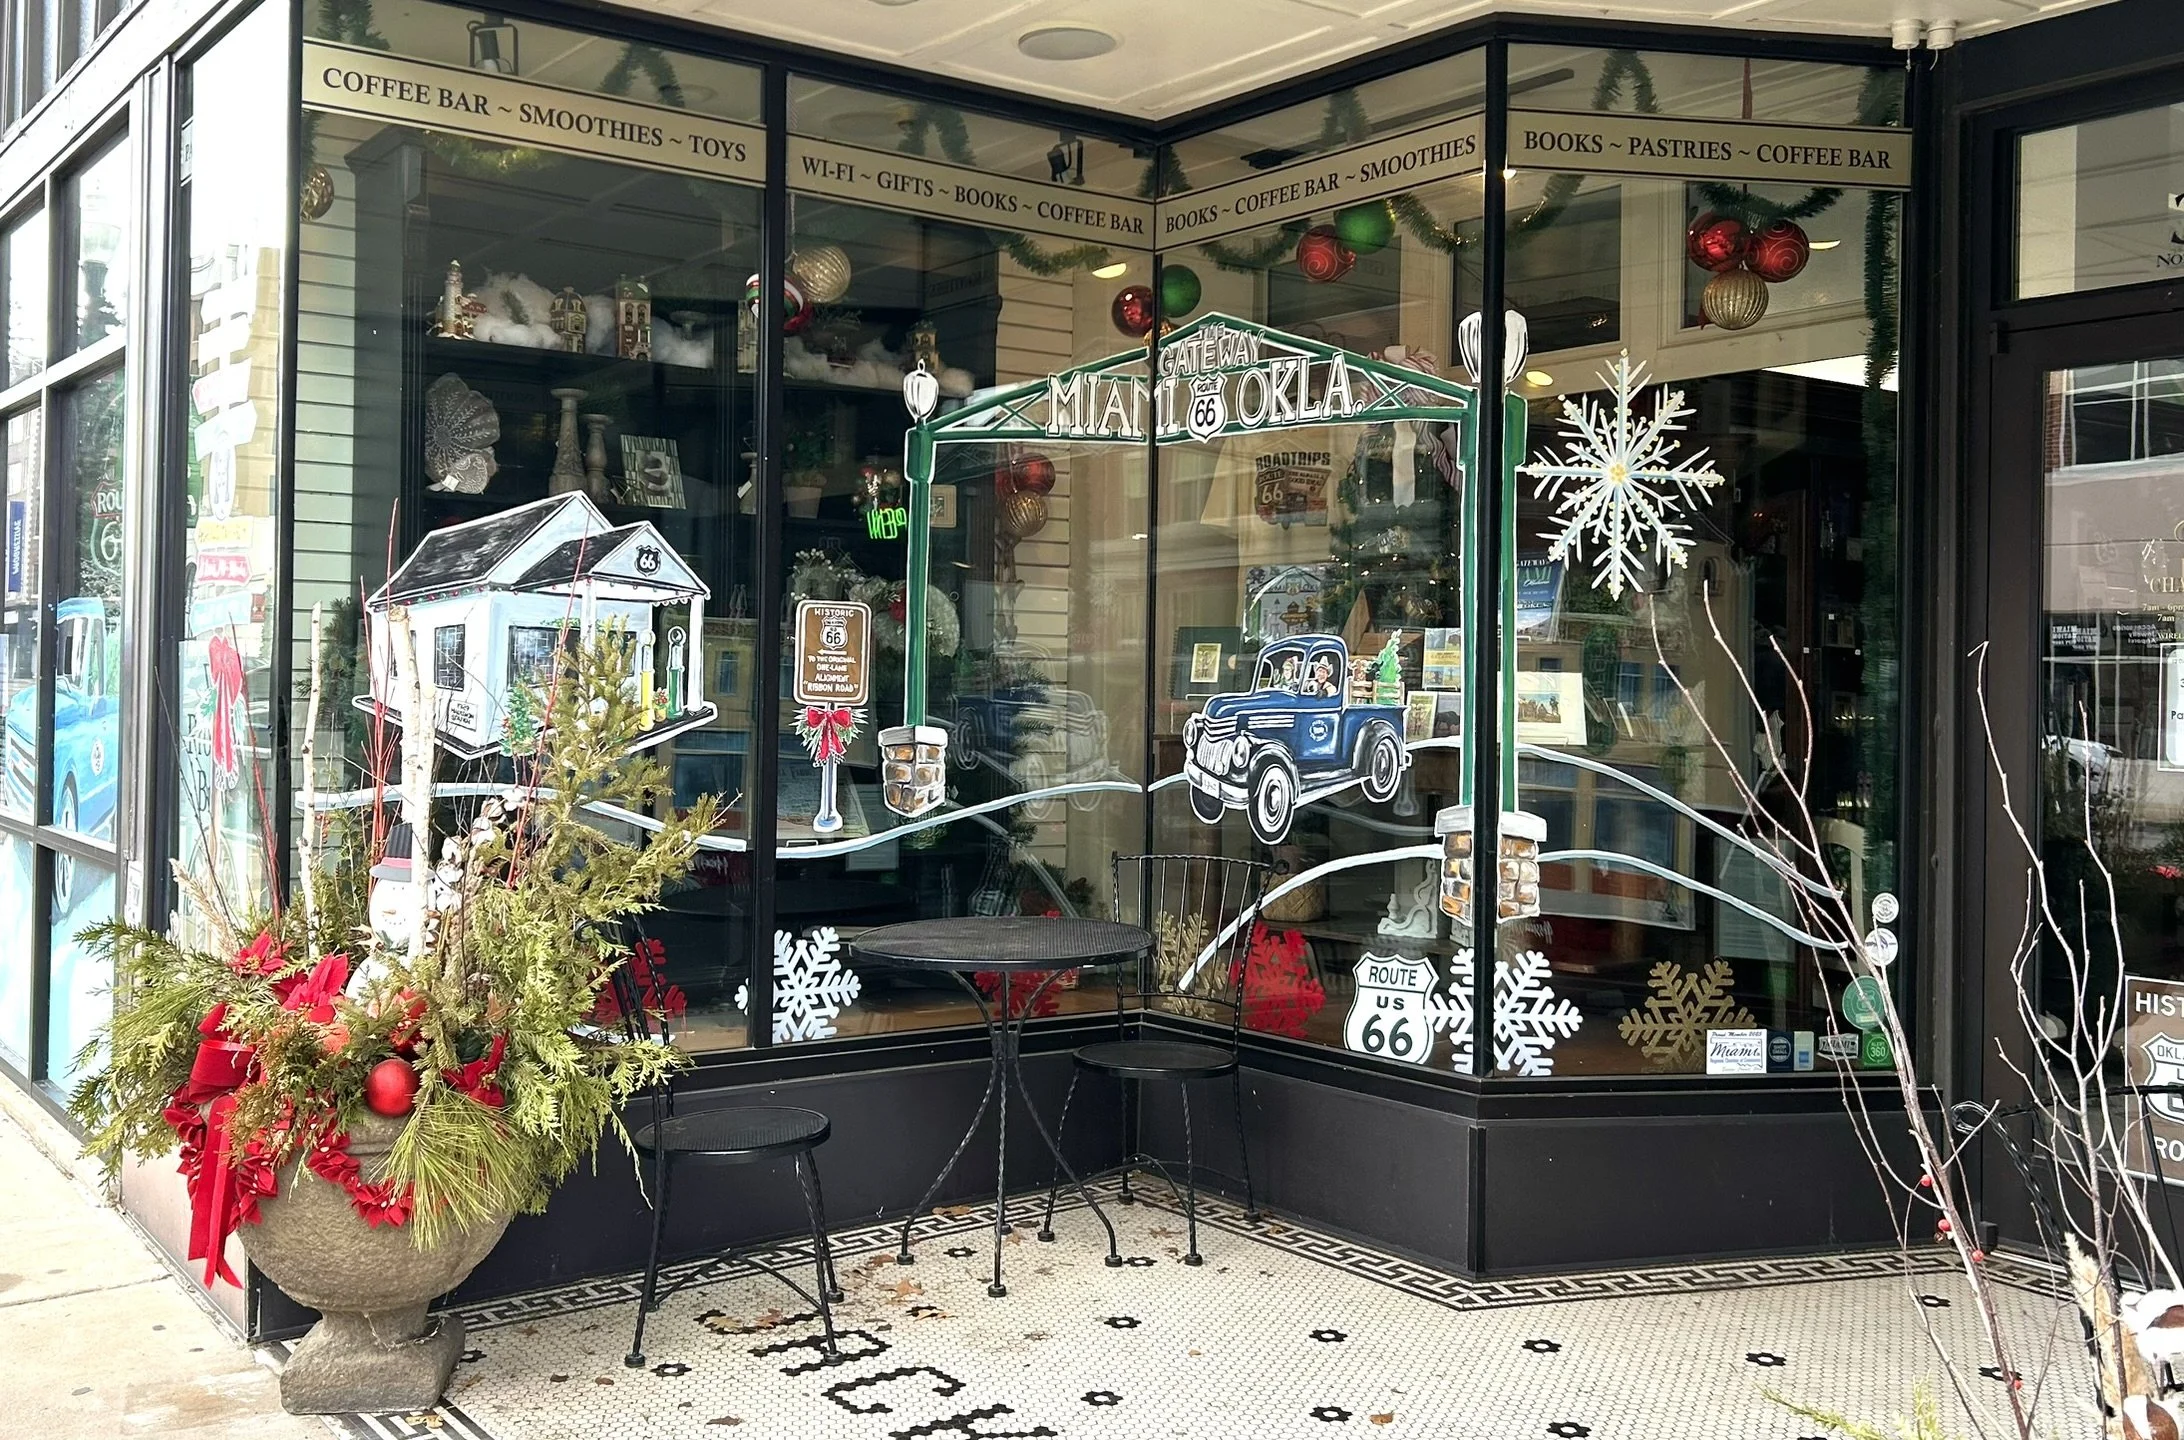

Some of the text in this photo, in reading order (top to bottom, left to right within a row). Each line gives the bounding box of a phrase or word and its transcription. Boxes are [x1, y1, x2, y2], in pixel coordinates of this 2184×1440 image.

[322, 67, 431, 105] COFFEE
[437, 87, 491, 117] BAR
[519, 103, 663, 147] SMOOTHIES
[688, 134, 747, 162] TOYS
[1524, 130, 1603, 154] BOOKS
[1628, 136, 1732, 161] PASTRIES
[1756, 143, 1843, 167] COFFEE
[1847, 147, 1893, 169] BAR
[1165, 205, 1218, 234] BOOKS
[1235, 182, 1301, 216] COFFEE
[1304, 172, 1340, 197] BAR
[1360, 134, 1476, 183] SMOOTHIES
[801, 155, 856, 184] WI-FI
[877, 170, 934, 197] GIFTS
[954, 185, 1018, 213] BOOKS
[1037, 201, 1106, 228] COFFEE
[1110, 214, 1145, 235] BAR
[1159, 329, 1265, 377] GATEWAY
[1197, 381, 1219, 393] ROUTE
[1195, 398, 1216, 427] 66
[1256, 452, 1331, 471] ROADTRIPS
[1262, 482, 1283, 504] 66
[639, 553, 655, 568] 66
[814, 608, 854, 617] HISTORIC
[826, 631, 841, 645] 66
[1369, 966, 1418, 986] ROUTE
[1362, 1013, 1413, 1057] 66
[1710, 1042, 1759, 1058] Miami
[1870, 1046, 1886, 1057] 360
[2157, 1044, 2184, 1060] OKL
